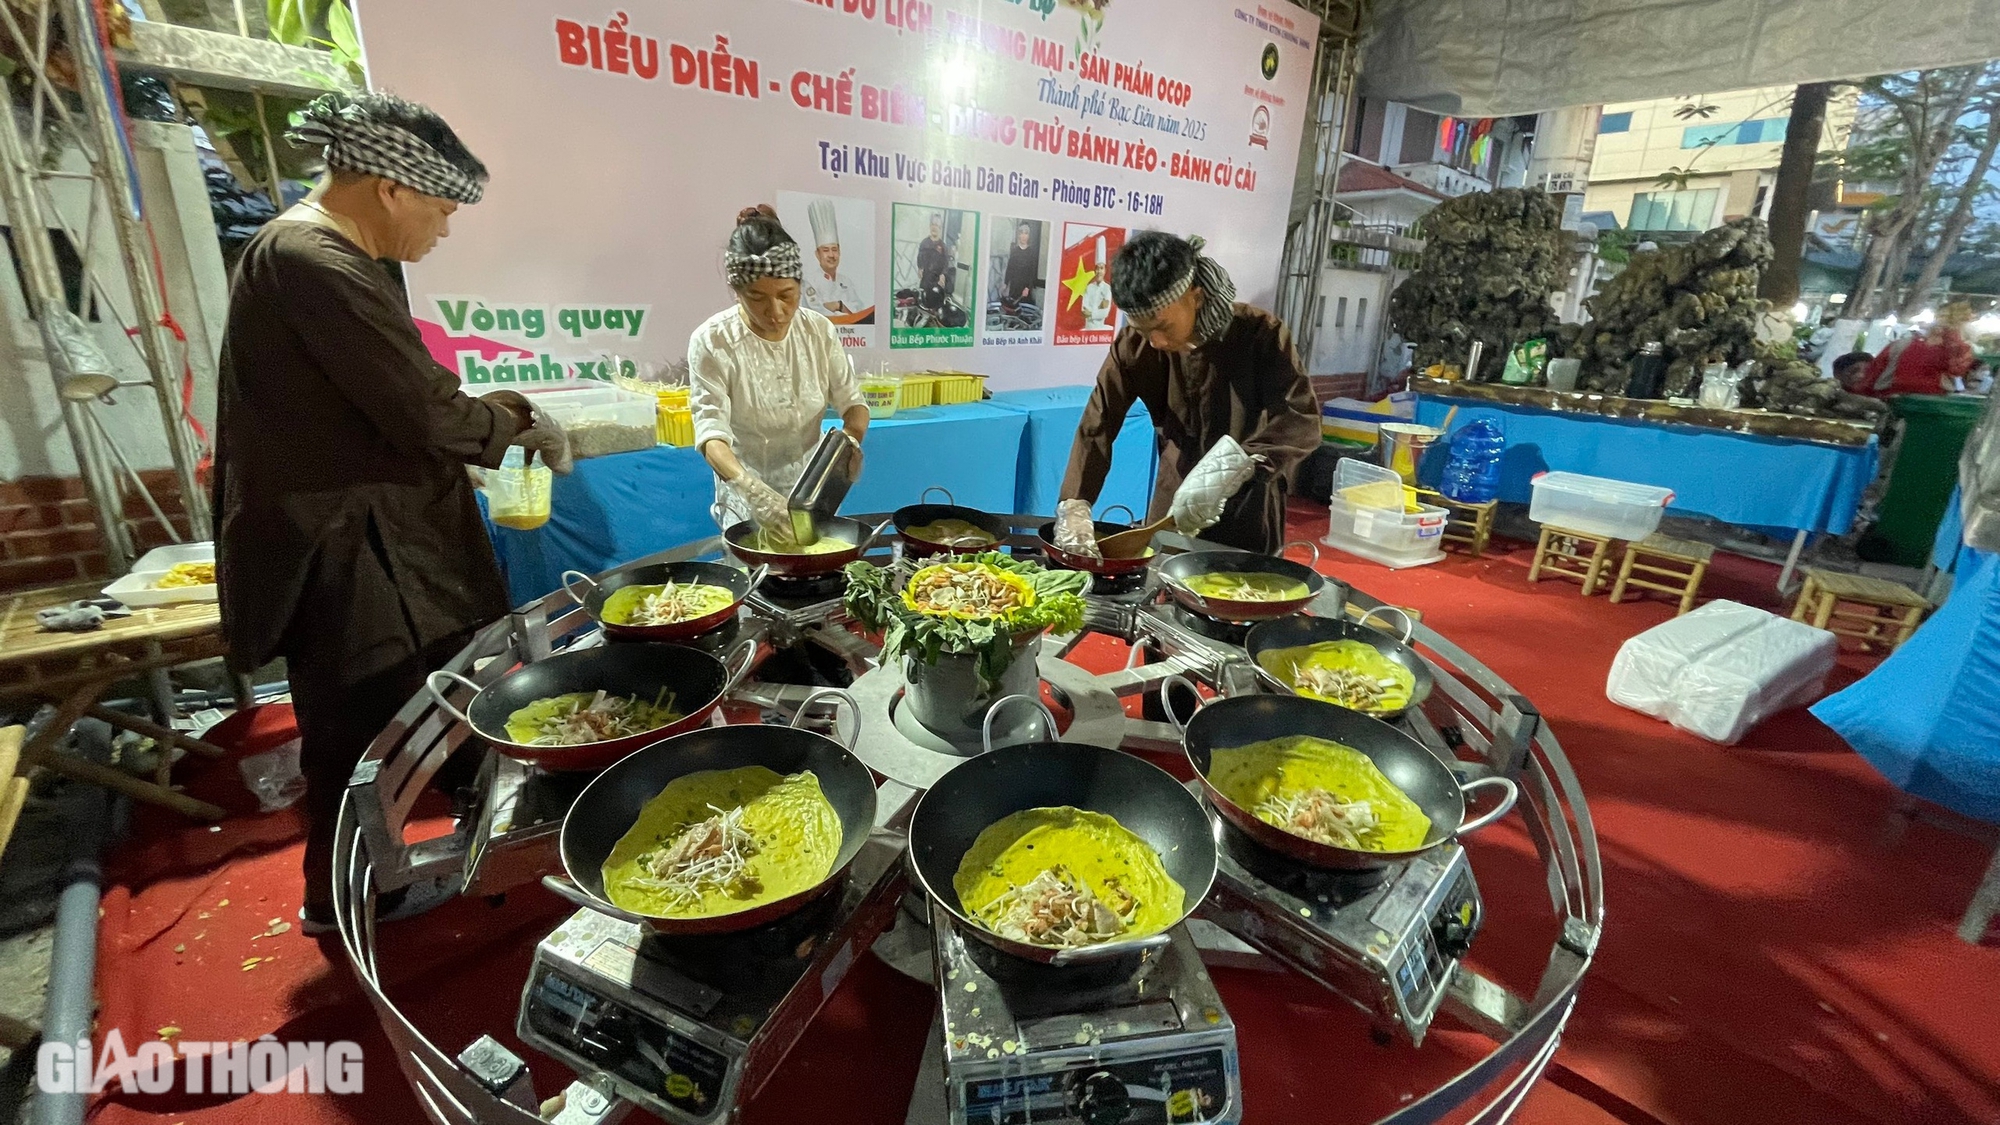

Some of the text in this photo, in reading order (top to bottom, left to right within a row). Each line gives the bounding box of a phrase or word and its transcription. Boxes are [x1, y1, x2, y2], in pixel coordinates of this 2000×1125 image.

[555, 11, 660, 80] BIỂU
[671, 34, 759, 99] DIỄN
[790, 67, 856, 116] CHẾ
[1023, 116, 1065, 155] THỬ
[1067, 126, 1120, 166] BÁNH
[1122, 138, 1158, 172] XÈO
[1170, 150, 1213, 183] BÁNH
[1214, 157, 1232, 188] CỦ
[1235, 162, 1257, 192] CẢI
[1031, 36, 1064, 77] MẠI
[1079, 47, 1110, 86] SẢN
[1114, 60, 1154, 98] PHẨM
[1157, 76, 1192, 108] OCOP
[1038, 76, 1079, 111] Thành
[1109, 97, 1131, 126] Bạc
[1157, 114, 1181, 135] năm
[1181, 117, 1207, 141] 2025
[818, 140, 848, 179] Tại
[854, 147, 890, 179] Khu
[895, 153, 927, 188] Vực
[932, 159, 972, 189] Bánh
[976, 166, 1004, 192] Dân
[1008, 171, 1039, 199] Gian
[1052, 179, 1090, 208] Phòng
[1093, 185, 1116, 209] BTC
[1127, 191, 1164, 215] 16-18H
[436, 299, 645, 339] Vòng quay
[464, 353, 564, 384] bánh
